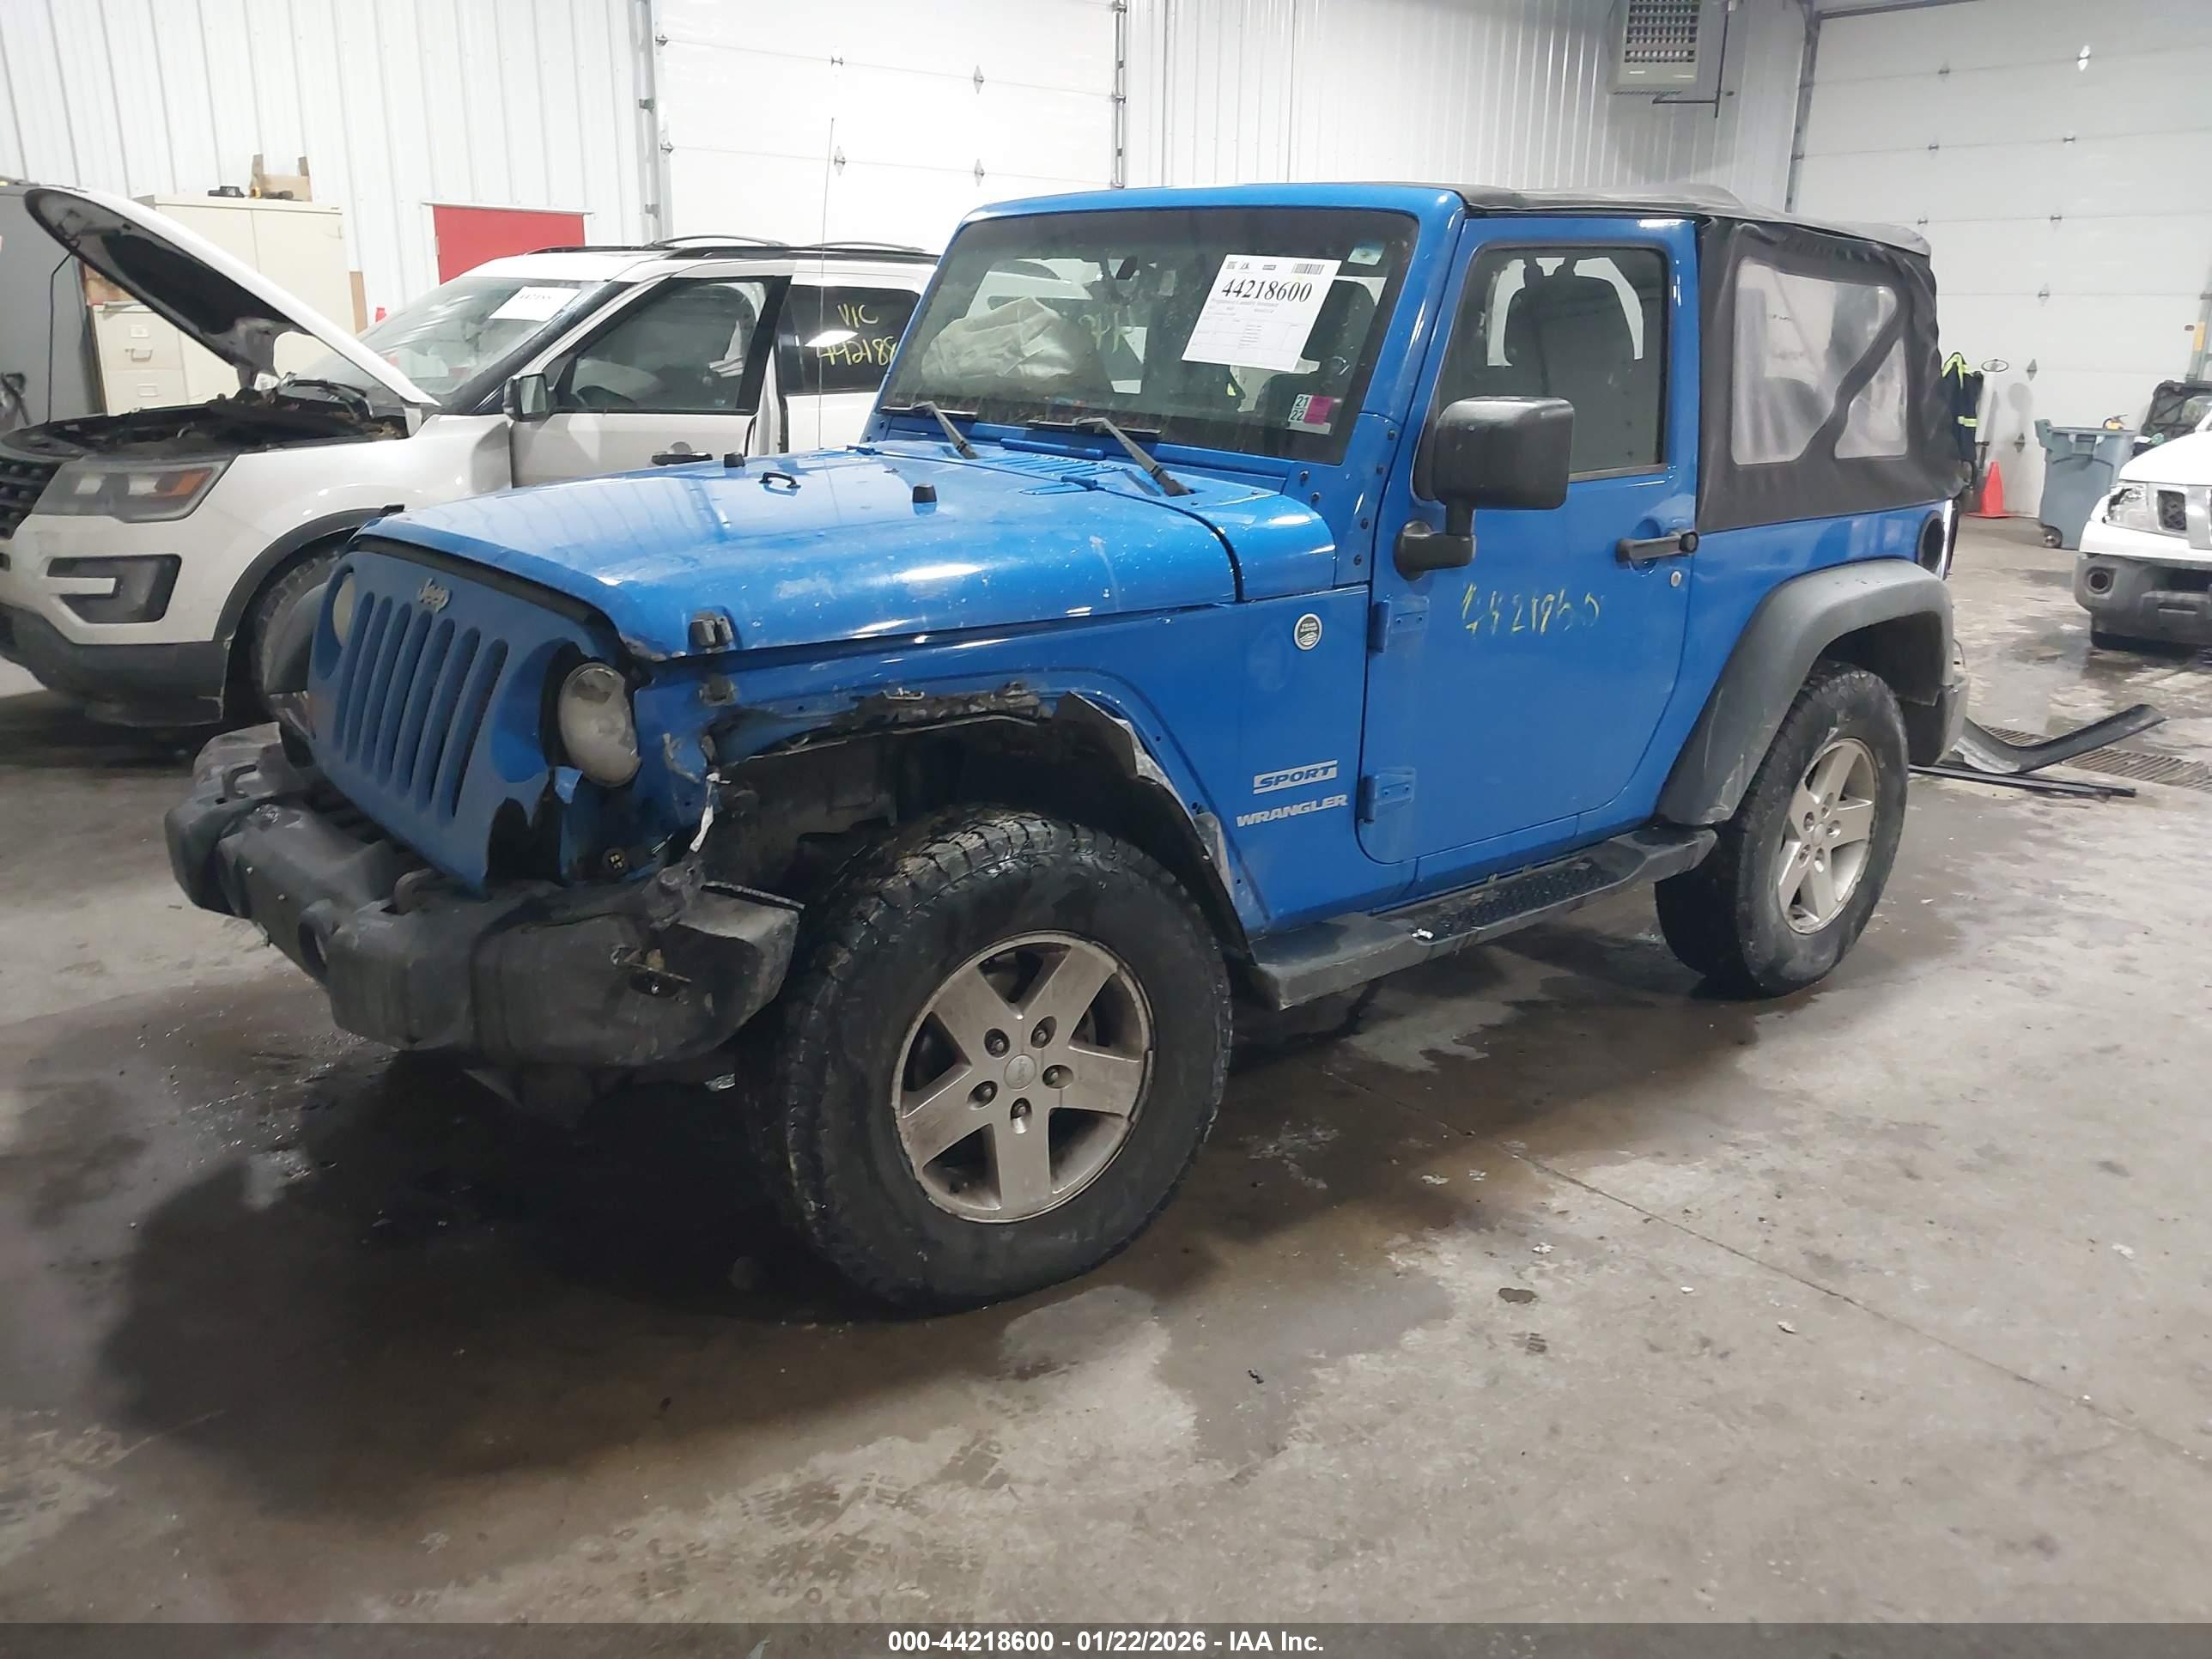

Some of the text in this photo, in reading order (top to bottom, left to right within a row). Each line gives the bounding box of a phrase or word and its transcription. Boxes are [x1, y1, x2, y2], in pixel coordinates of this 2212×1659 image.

[1222, 279, 1313, 302] 44218600
[1296, 395, 1310, 407] 21
[1290, 409, 1304, 421] 22
[1255, 763, 1338, 790] SPORT
[1237, 794, 1348, 827] WRANGLER
